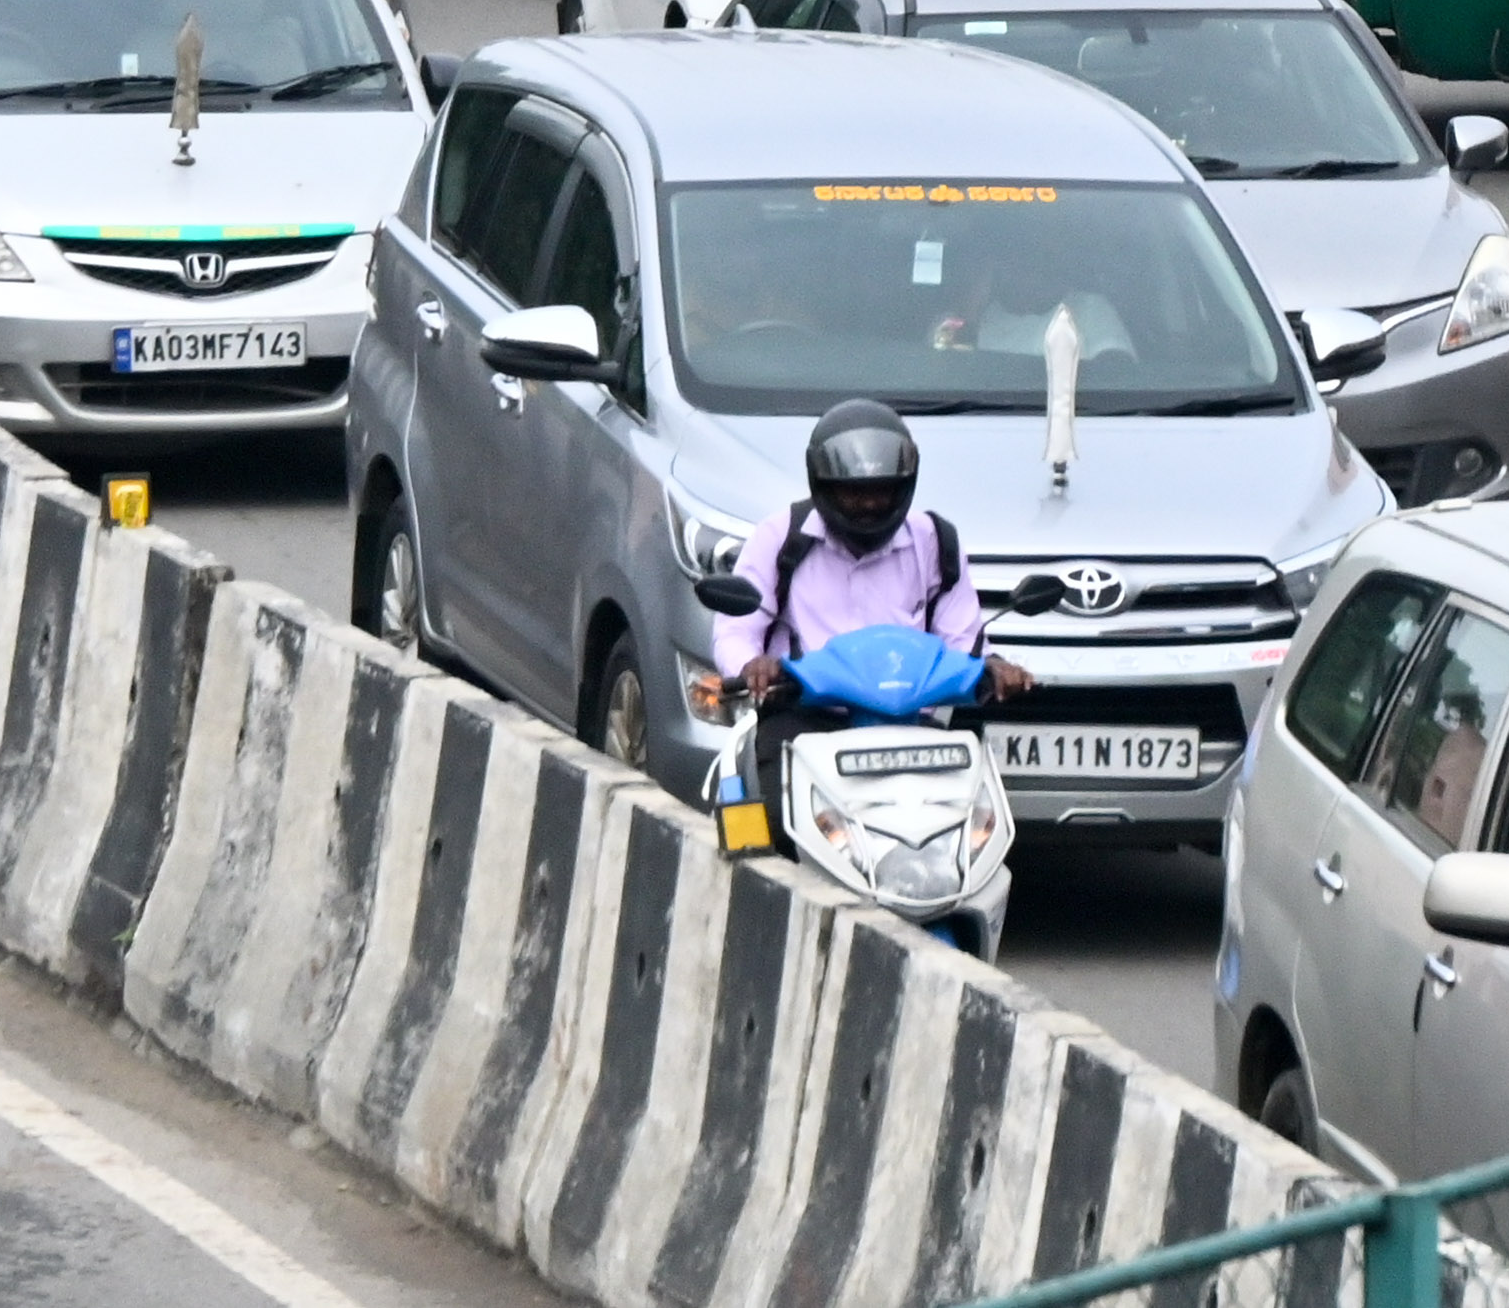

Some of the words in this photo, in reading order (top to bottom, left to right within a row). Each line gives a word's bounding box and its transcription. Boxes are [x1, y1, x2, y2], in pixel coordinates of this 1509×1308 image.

[813, 184, 925, 202] ಕರ್ನಾಟಕ
[966, 185, 1057, 203] ಸರ್ಕಾರ
[133, 331, 302, 362] KA03MF7143
[1006, 735, 1042, 767] KA
[1054, 737, 1086, 767] 11
[1094, 737, 1112, 767] N
[1122, 738, 1192, 769] 1873
